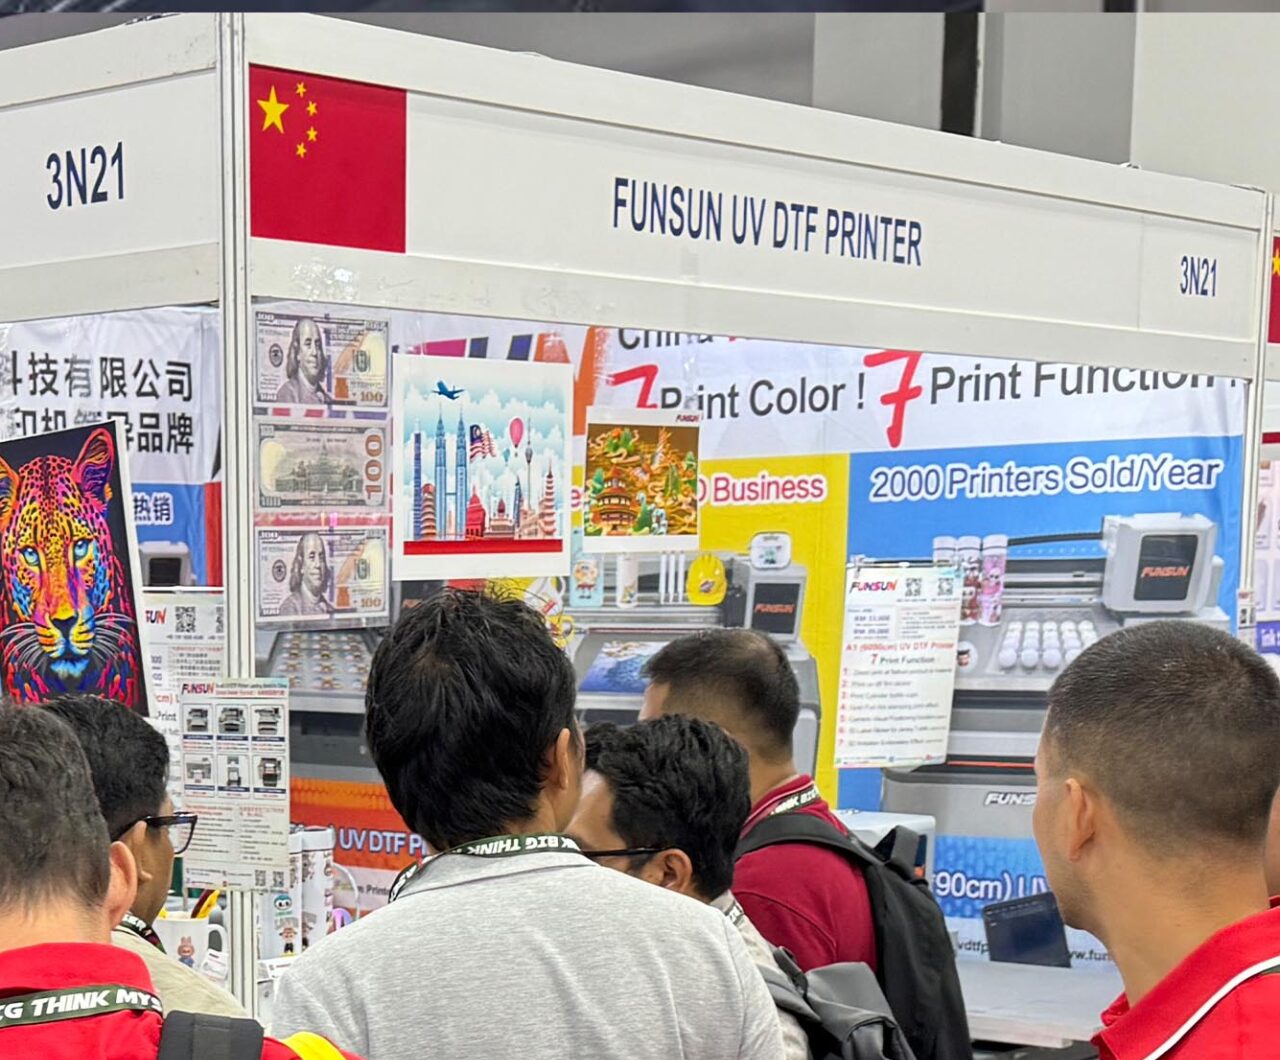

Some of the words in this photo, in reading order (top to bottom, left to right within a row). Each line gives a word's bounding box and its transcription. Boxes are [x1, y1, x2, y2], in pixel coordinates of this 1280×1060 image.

[46, 141, 124, 209] 3N21
[613, 177, 722, 241] FUNSUN
[733, 194, 766, 246] UV
[773, 201, 818, 252] DTF
[825, 208, 921, 266] PRINTER
[1180, 256, 1218, 298] 3N21
[661, 384, 739, 420] Pint
[750, 377, 846, 416] Color
[863, 350, 925, 448] 7
[931, 363, 1021, 405] Print
[713, 474, 825, 502] Business
[872, 468, 940, 498] 2000
[949, 462, 1060, 495] Printers
[1068, 456, 1221, 489] Sold/Year
[1141, 565, 1189, 578] FUNSUN
[850, 579, 898, 593] FUNSUN
[985, 791, 1037, 806] FUNS
[339, 828, 367, 850] UV
[370, 830, 407, 854] DTF
[31, 989, 110, 1017] THINK
